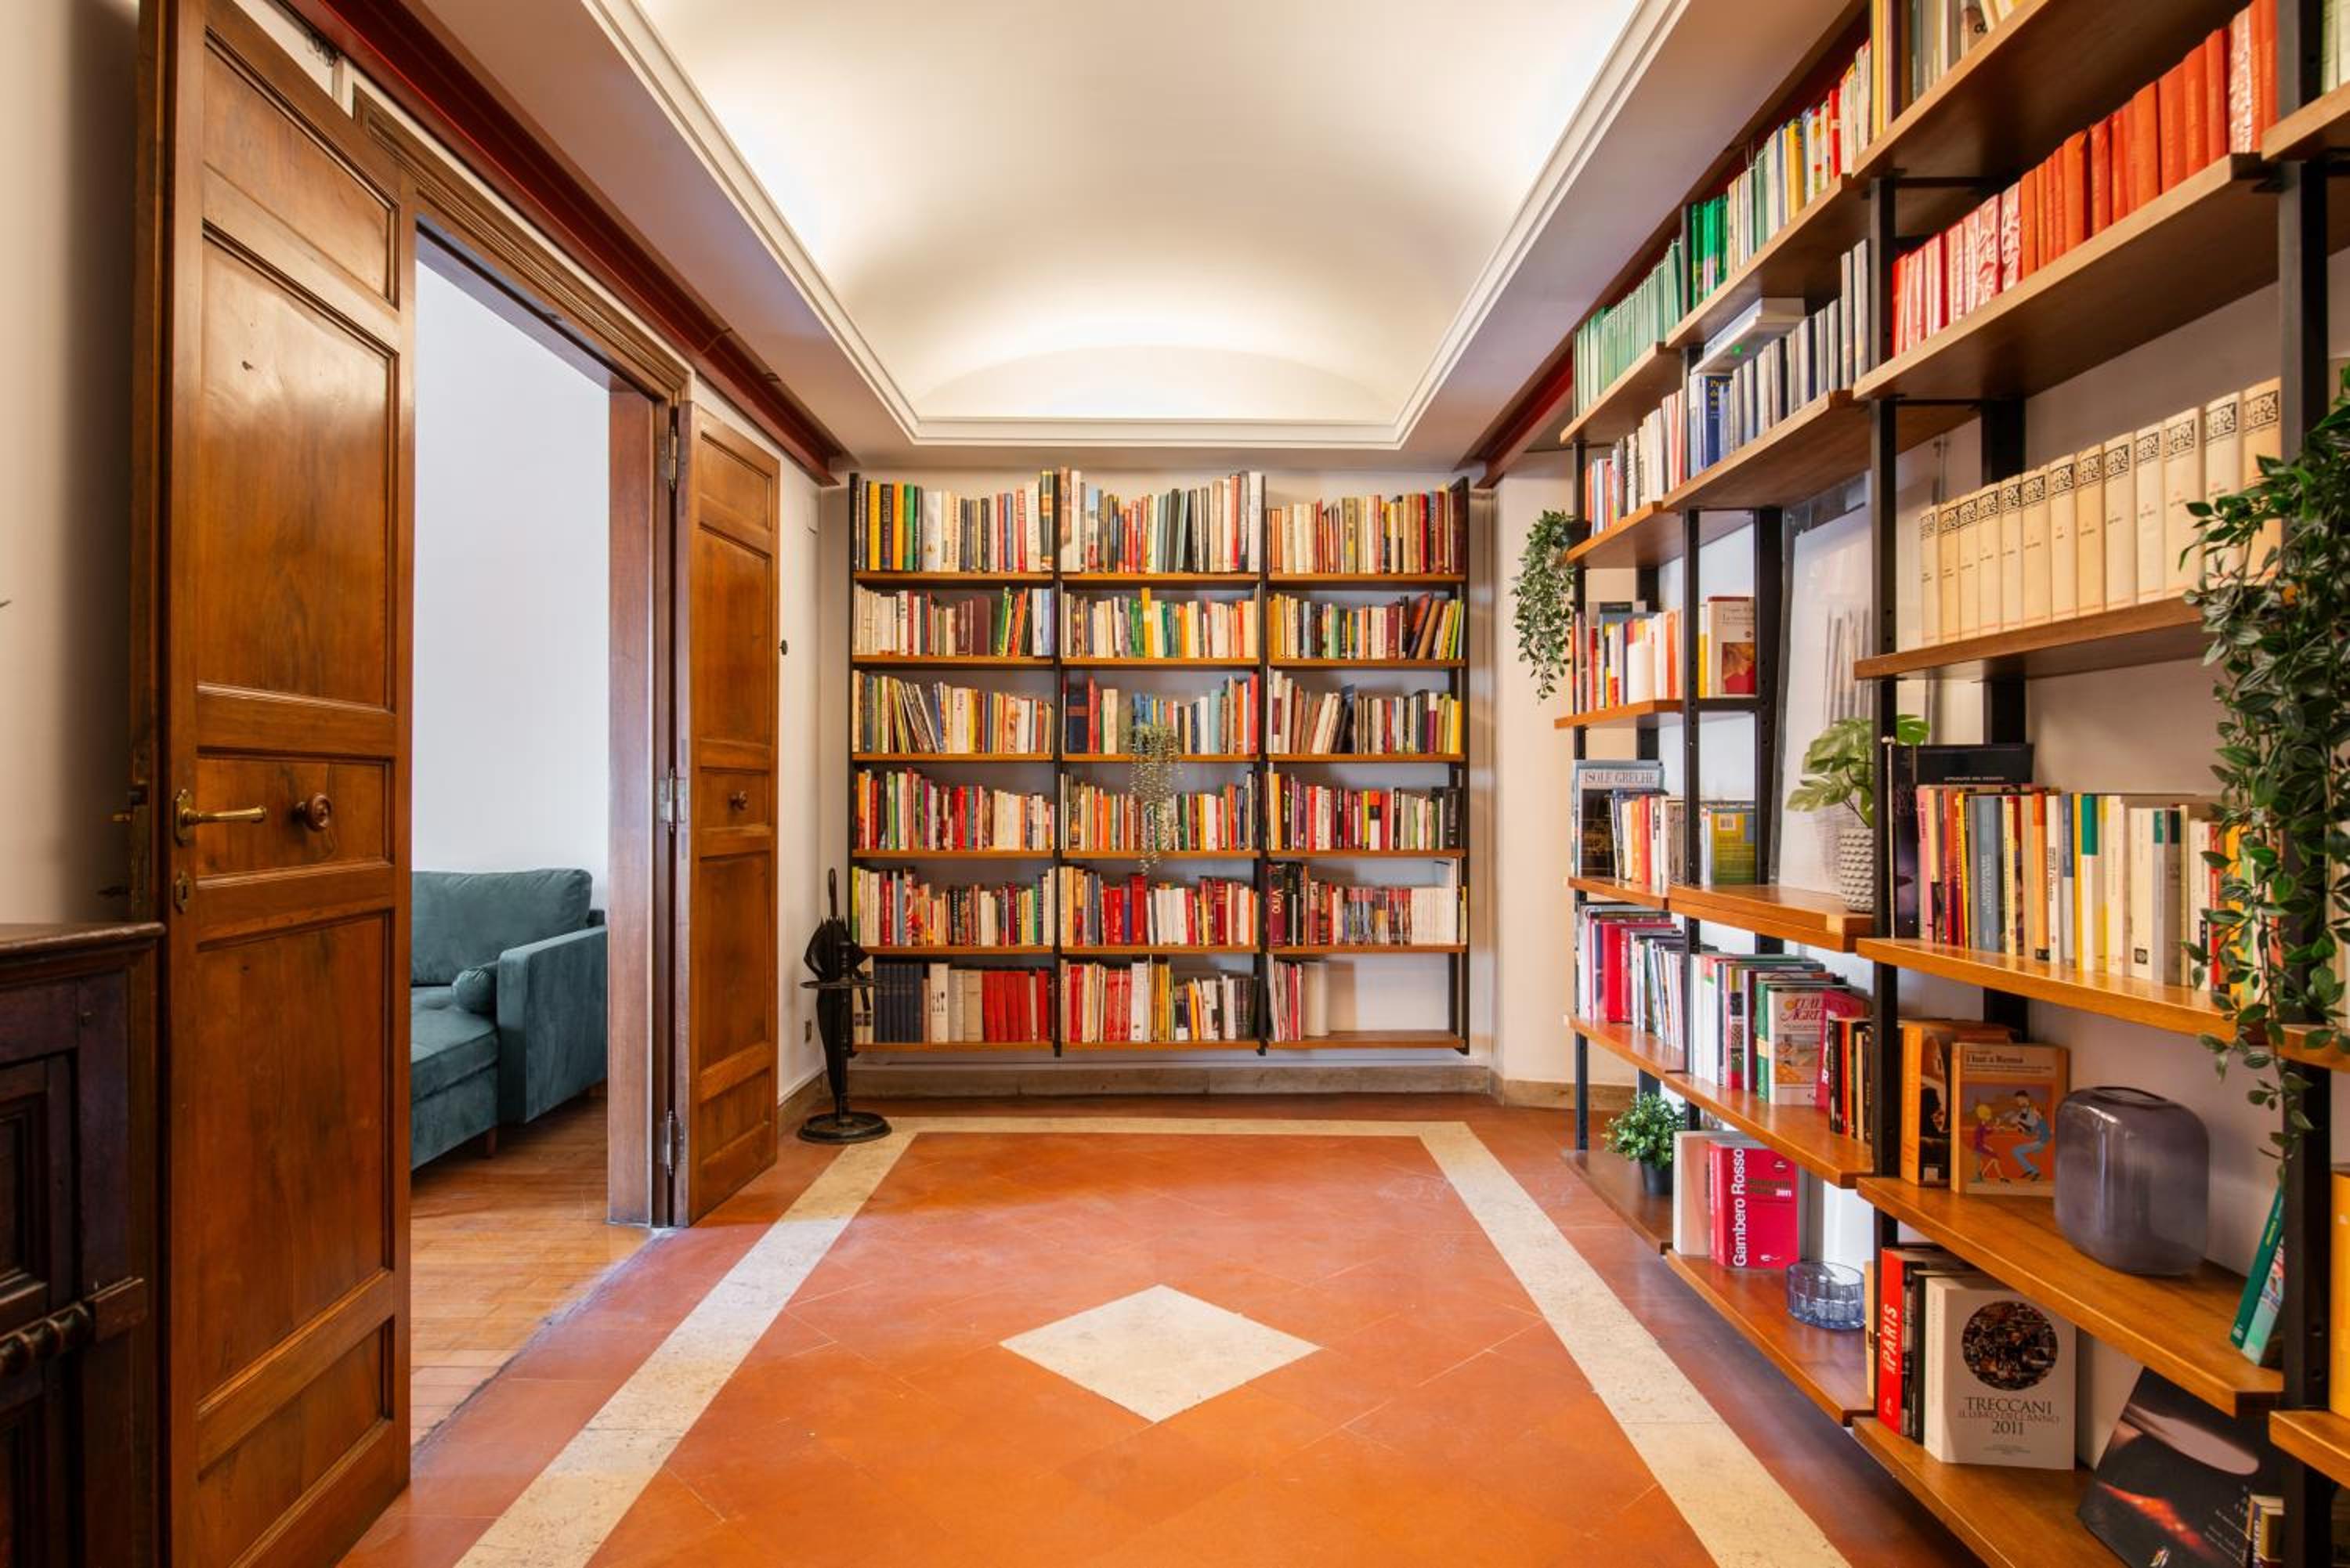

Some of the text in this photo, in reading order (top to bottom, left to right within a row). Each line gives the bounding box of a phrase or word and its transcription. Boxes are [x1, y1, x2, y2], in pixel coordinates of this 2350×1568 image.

[1271, 889, 1284, 914] Vino
[1731, 1149, 1747, 1266] Gambero Rosso
[1964, 1396, 2052, 1415] TRECCANI
[1993, 1420, 2024, 1436] 2011
